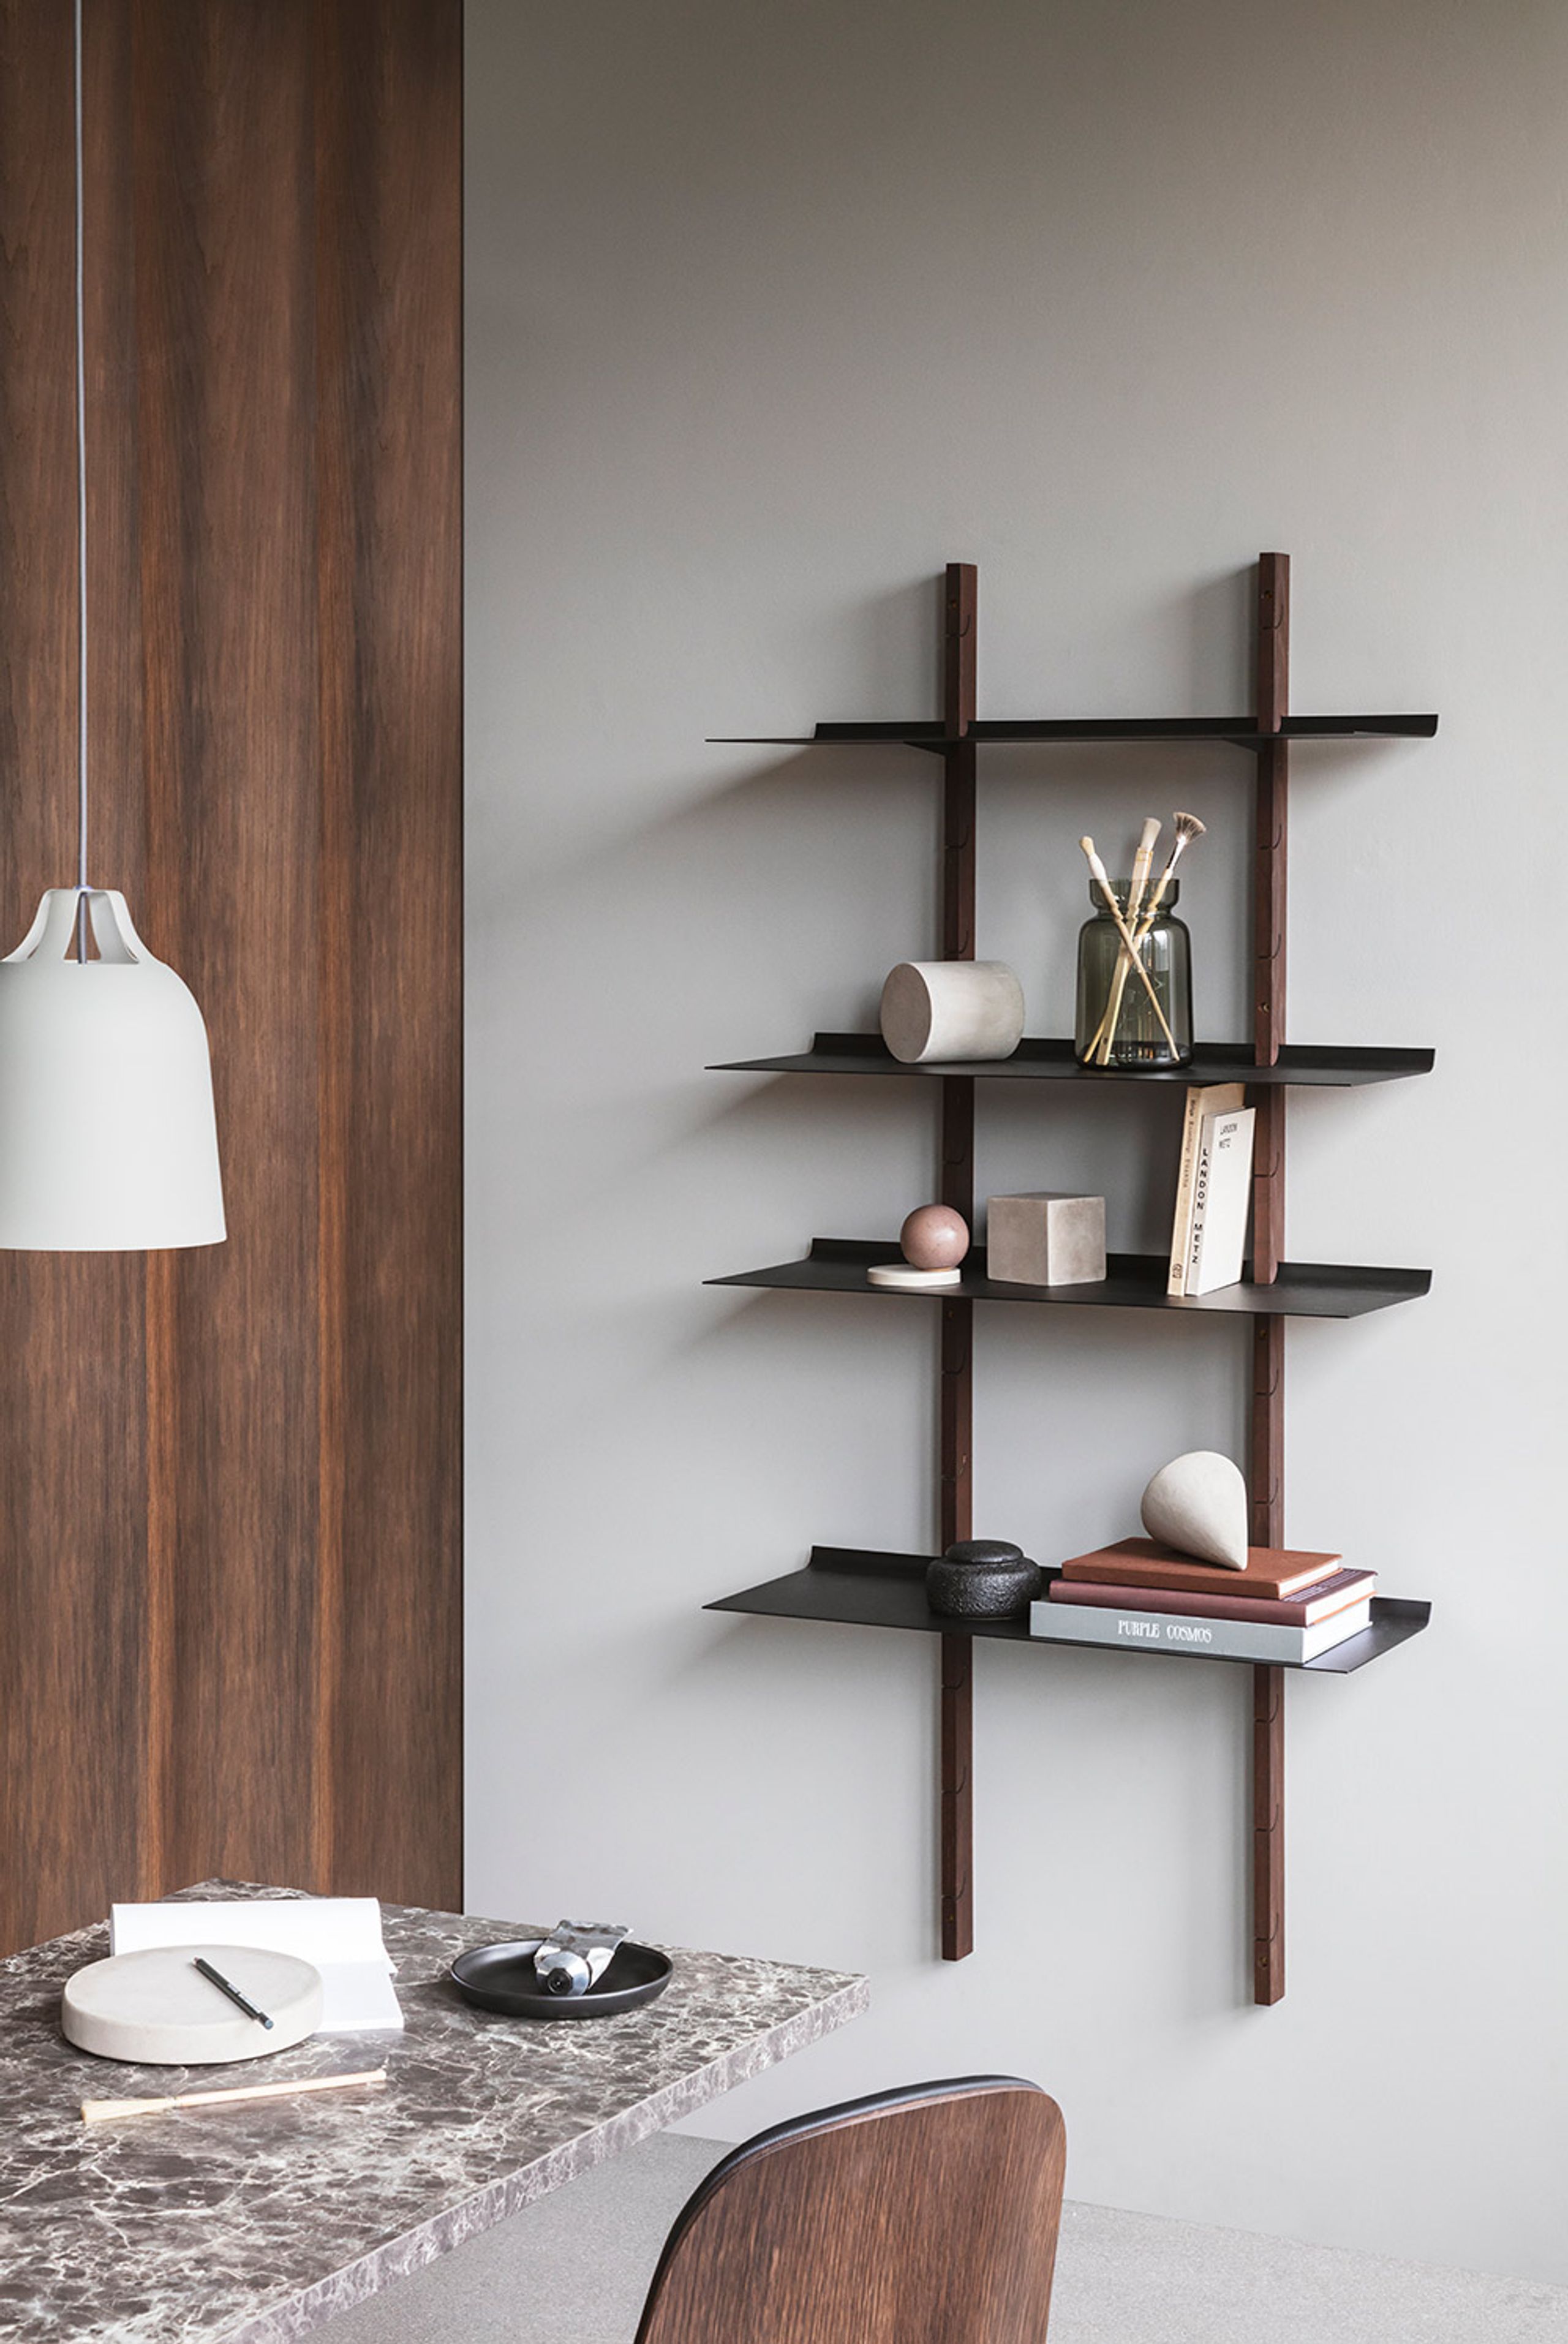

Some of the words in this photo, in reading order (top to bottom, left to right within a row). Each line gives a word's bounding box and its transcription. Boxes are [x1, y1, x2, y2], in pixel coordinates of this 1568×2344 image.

[1196, 1148, 1208, 1210] LANDON
[1191, 1223, 1203, 1264] METZ
[1118, 1619, 1160, 1639] PURPLE
[1166, 1624, 1212, 1644] COSMOS
